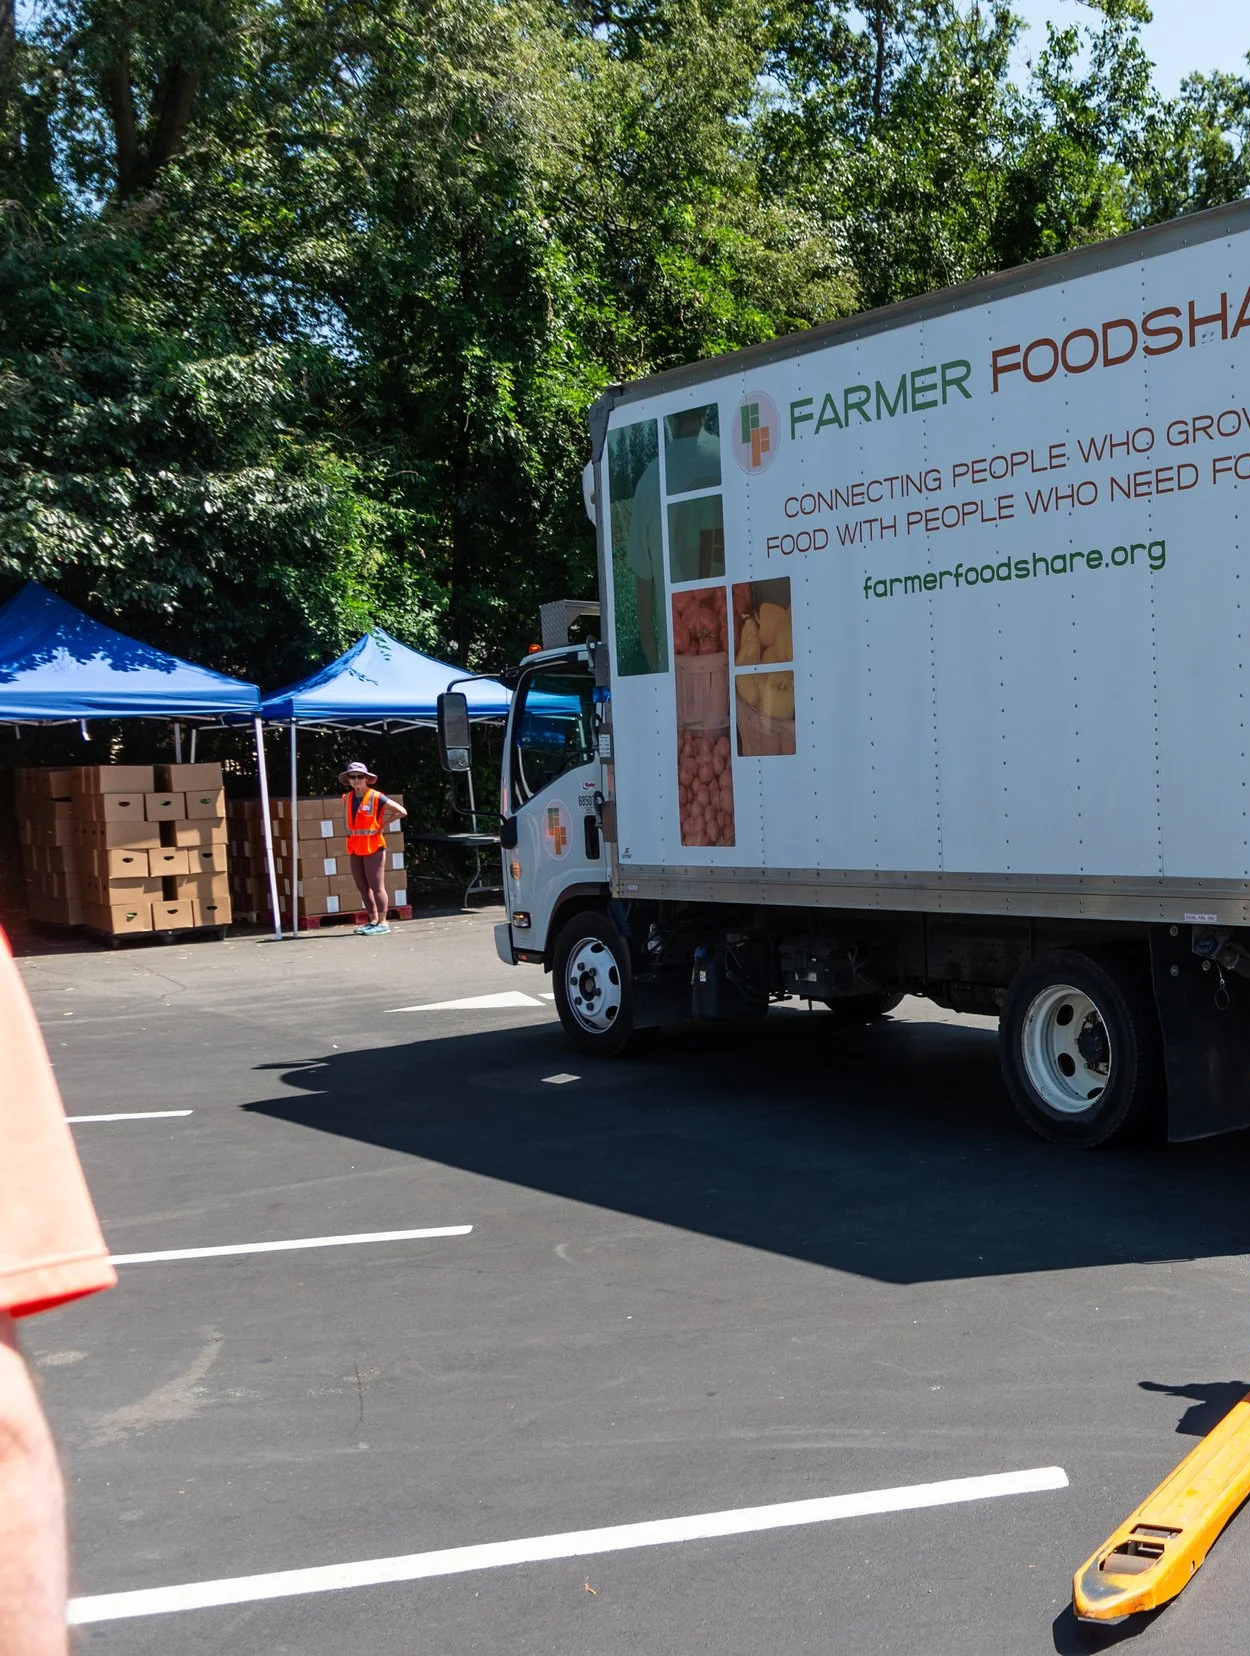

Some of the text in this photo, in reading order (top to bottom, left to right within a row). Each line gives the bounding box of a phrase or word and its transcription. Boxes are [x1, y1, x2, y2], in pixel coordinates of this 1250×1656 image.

[790, 359, 973, 441] FARMER
[765, 528, 829, 559] FOOD
[836, 514, 897, 547] WITH
[906, 494, 1016, 536] PEOPLE
[1025, 480, 1099, 515] WHO
[1109, 463, 1200, 503] NEED
[784, 469, 943, 520] CONNECTING
[951, 442, 1068, 489] PEOPLE
[1077, 426, 1156, 463] WHO
[862, 539, 1168, 600] farmerfoodshare.org
